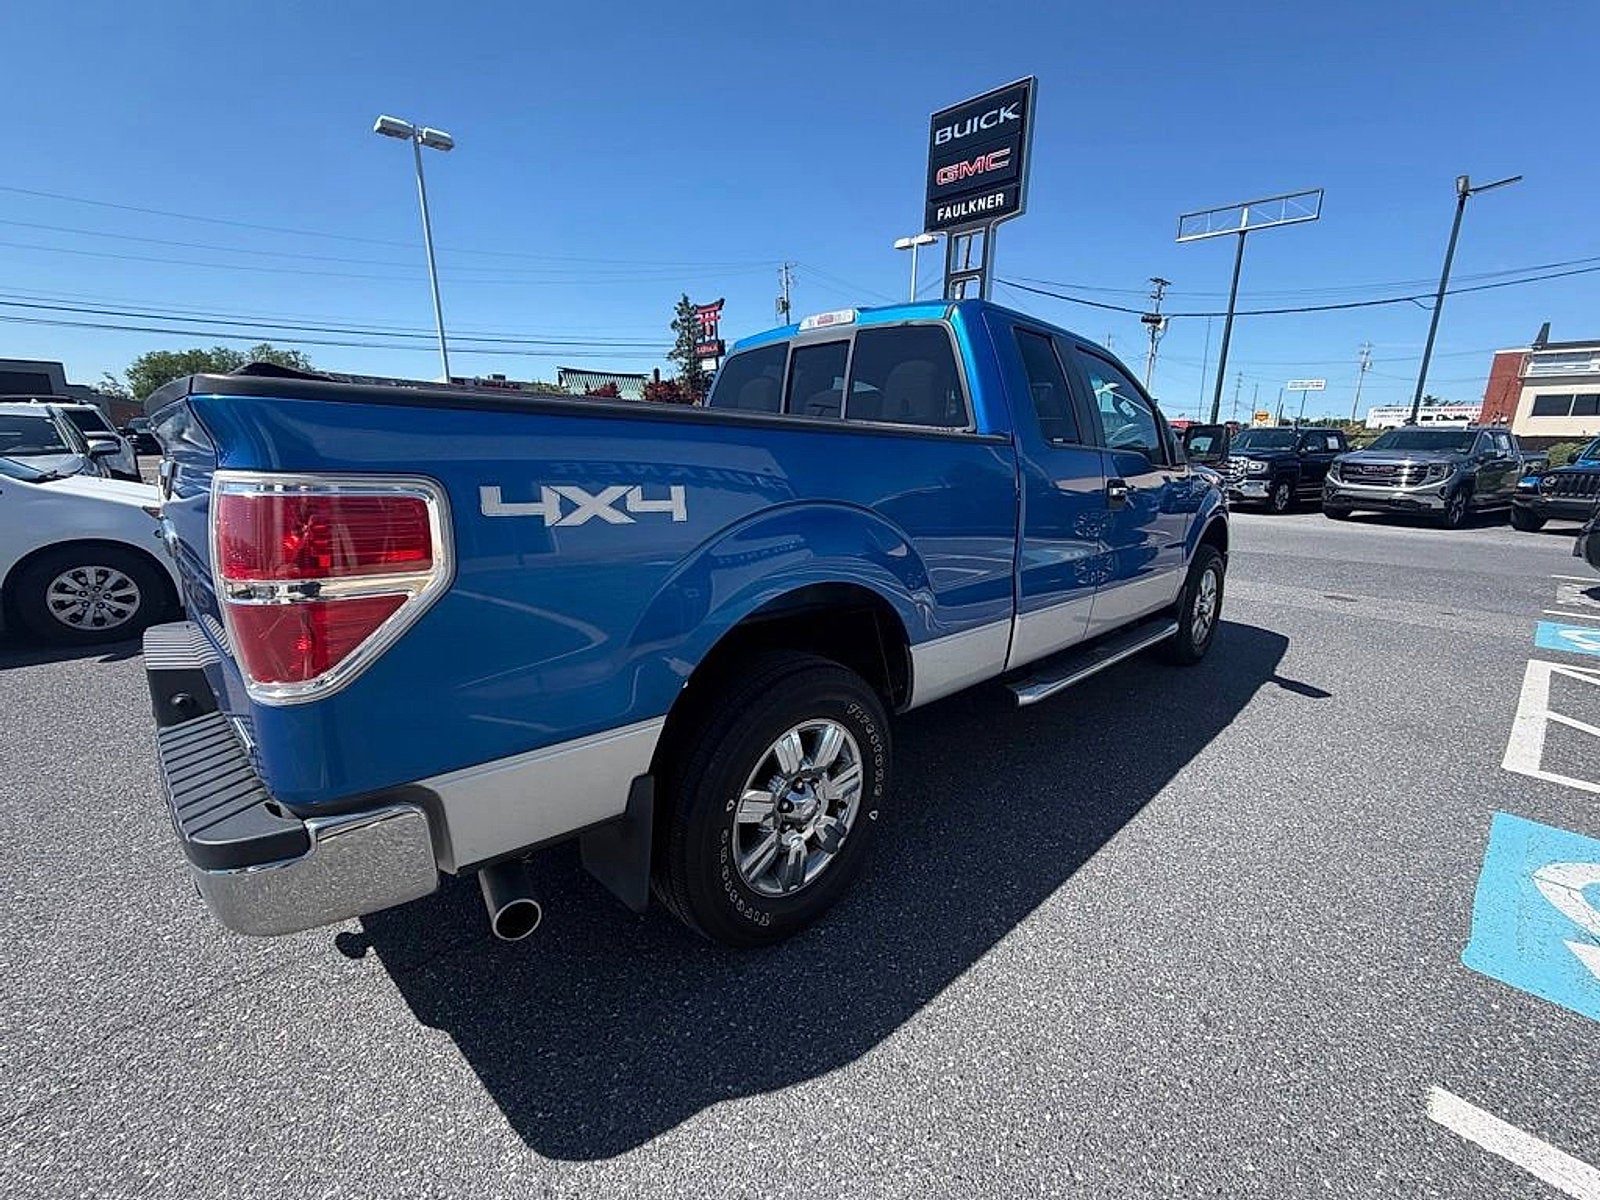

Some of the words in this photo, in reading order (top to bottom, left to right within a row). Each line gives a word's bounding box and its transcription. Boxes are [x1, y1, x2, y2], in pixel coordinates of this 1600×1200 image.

[934, 101, 1020, 145] BUICK
[936, 148, 1011, 186] GMC
[937, 193, 1004, 222] FAULKNER
